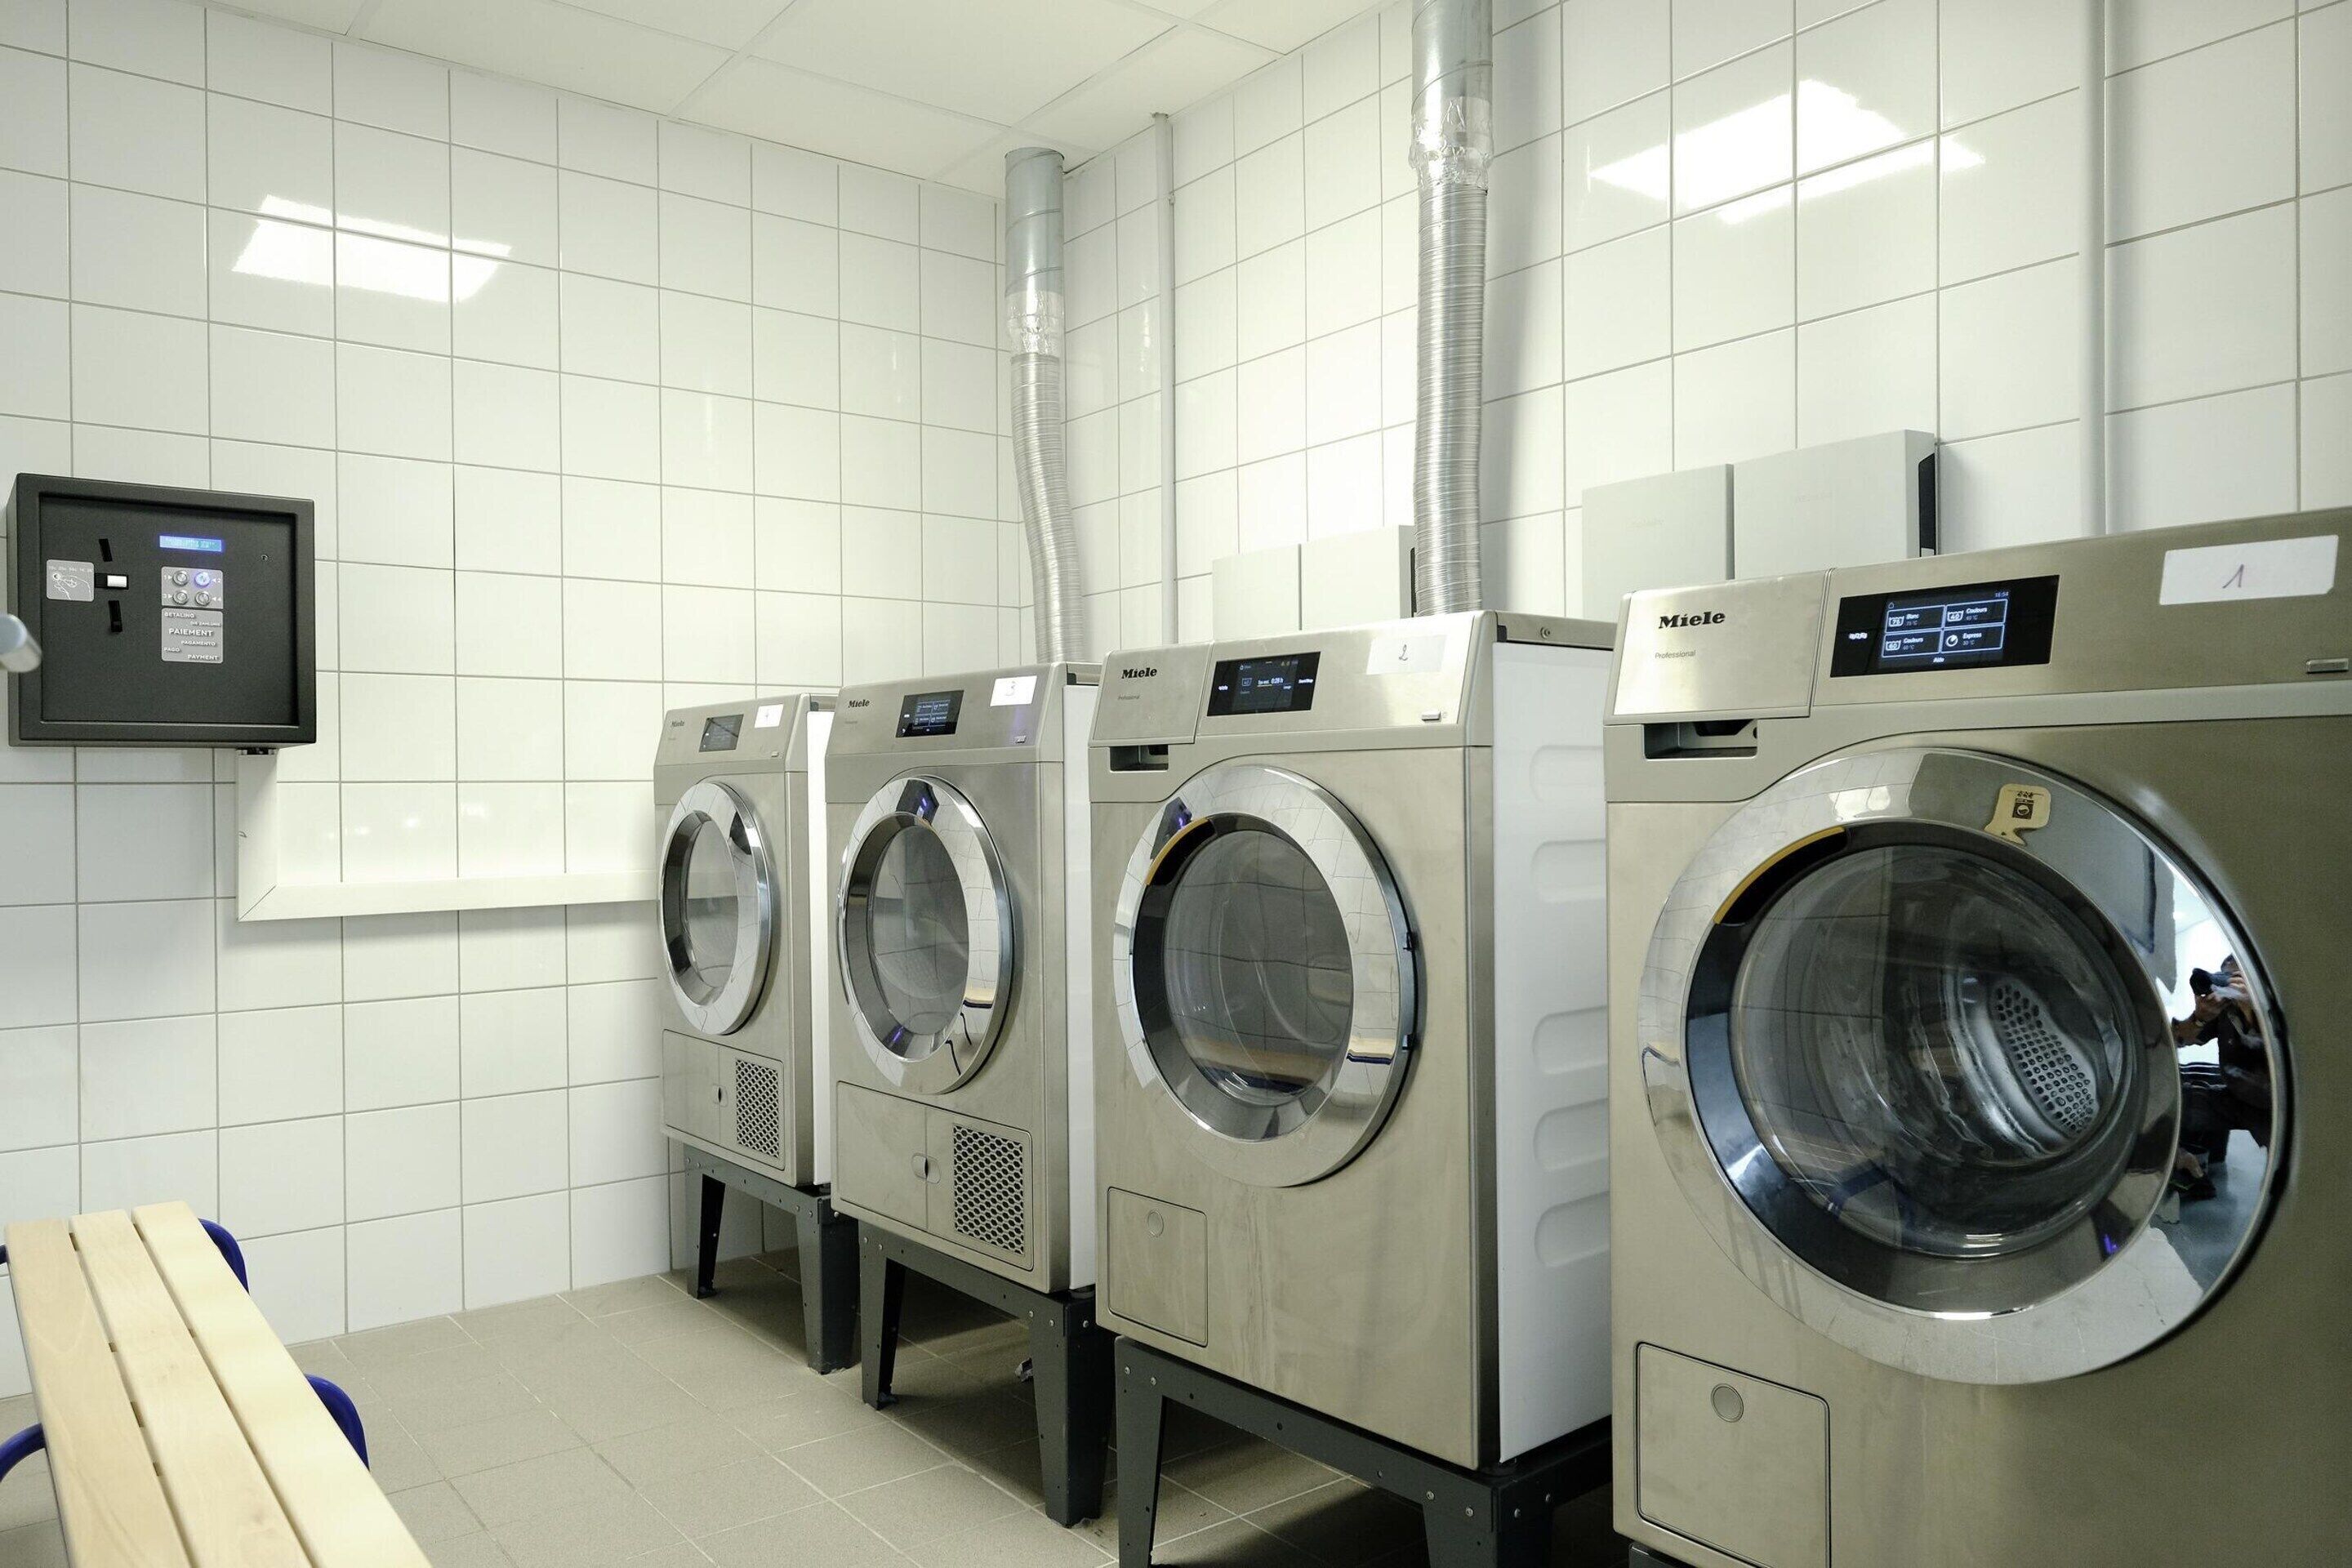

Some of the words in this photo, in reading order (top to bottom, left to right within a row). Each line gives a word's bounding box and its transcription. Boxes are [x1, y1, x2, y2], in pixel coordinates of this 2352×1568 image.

[2221, 564, 2244, 589] 1
[1658, 611, 1726, 629] Miele
[168, 627, 214, 636] PAIEMENT
[1398, 644, 1409, 662] 2
[1655, 649, 1696, 659] Professional
[1121, 666, 1158, 679] Miele
[848, 699, 871, 709] Miele
